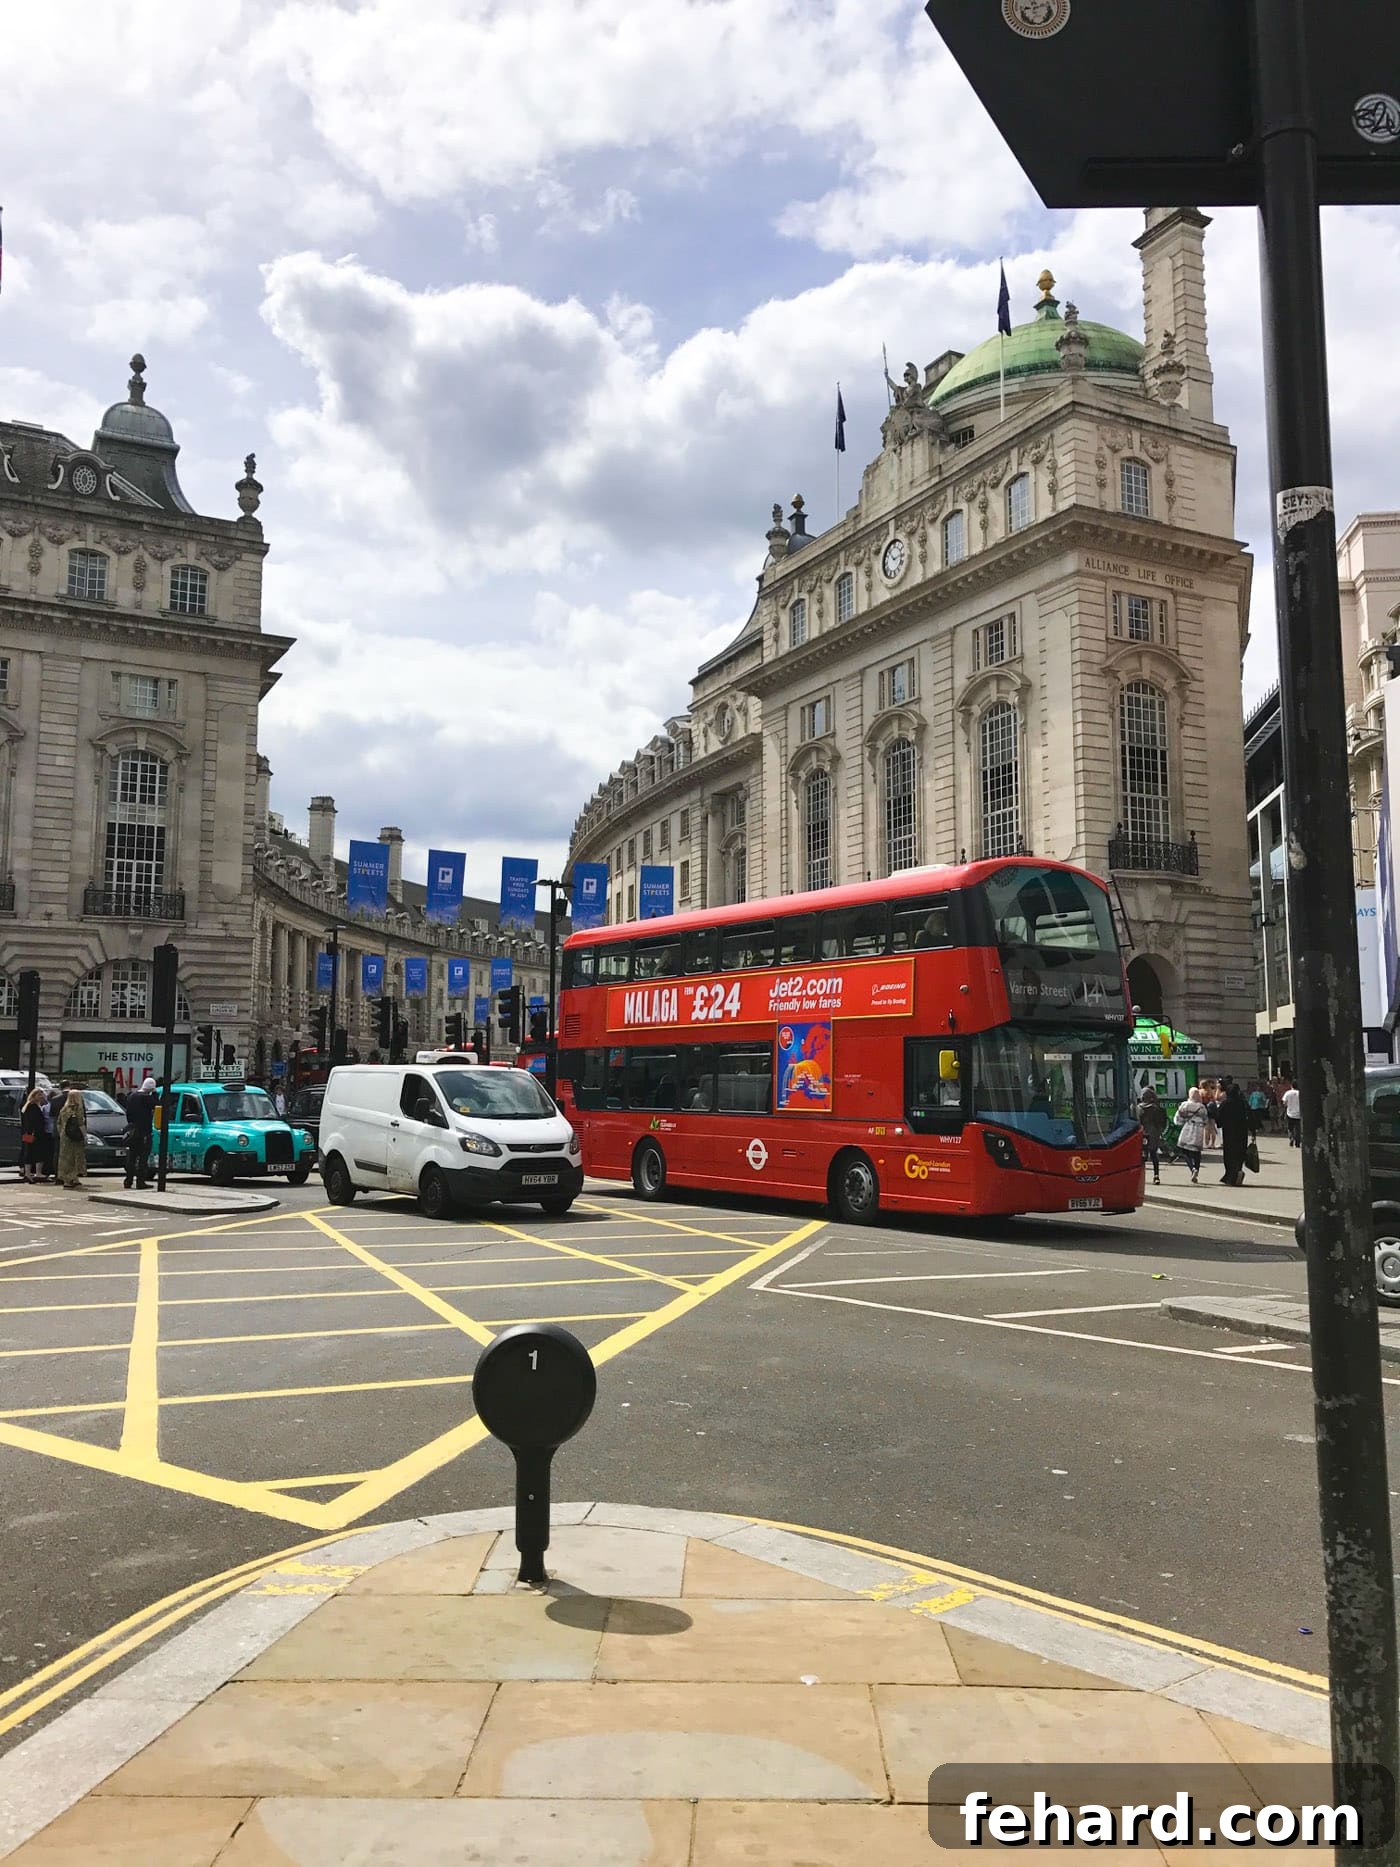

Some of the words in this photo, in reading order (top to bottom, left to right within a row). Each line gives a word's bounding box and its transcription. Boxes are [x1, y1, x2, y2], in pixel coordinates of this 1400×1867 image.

[1085, 557, 1130, 577] ALLIANCE
[1138, 568, 1157, 582] LIFE
[1165, 574, 1195, 590] OFFICE
[352, 868, 385, 877] STREETS
[353, 860, 385, 870] SUMMER
[769, 976, 843, 998] Jet2.com
[880, 982, 907, 990] BOEING
[1040, 983, 1067, 997] Street
[1083, 978, 1102, 1004] 14
[624, 987, 678, 1024] MALAGA
[691, 982, 741, 1021] £24
[768, 998, 800, 1013] Friendly
[802, 998, 818, 1009] low
[819, 996, 842, 1009] fares
[97, 1052, 118, 1061] THE
[121, 1052, 153, 1062] STING
[1141, 1045, 1152, 1053] IN
[940, 1135, 962, 1144] WHV127
[904, 1153, 928, 1179] Go
[1071, 1155, 1088, 1171] Go
[528, 1349, 538, 1370] 1
